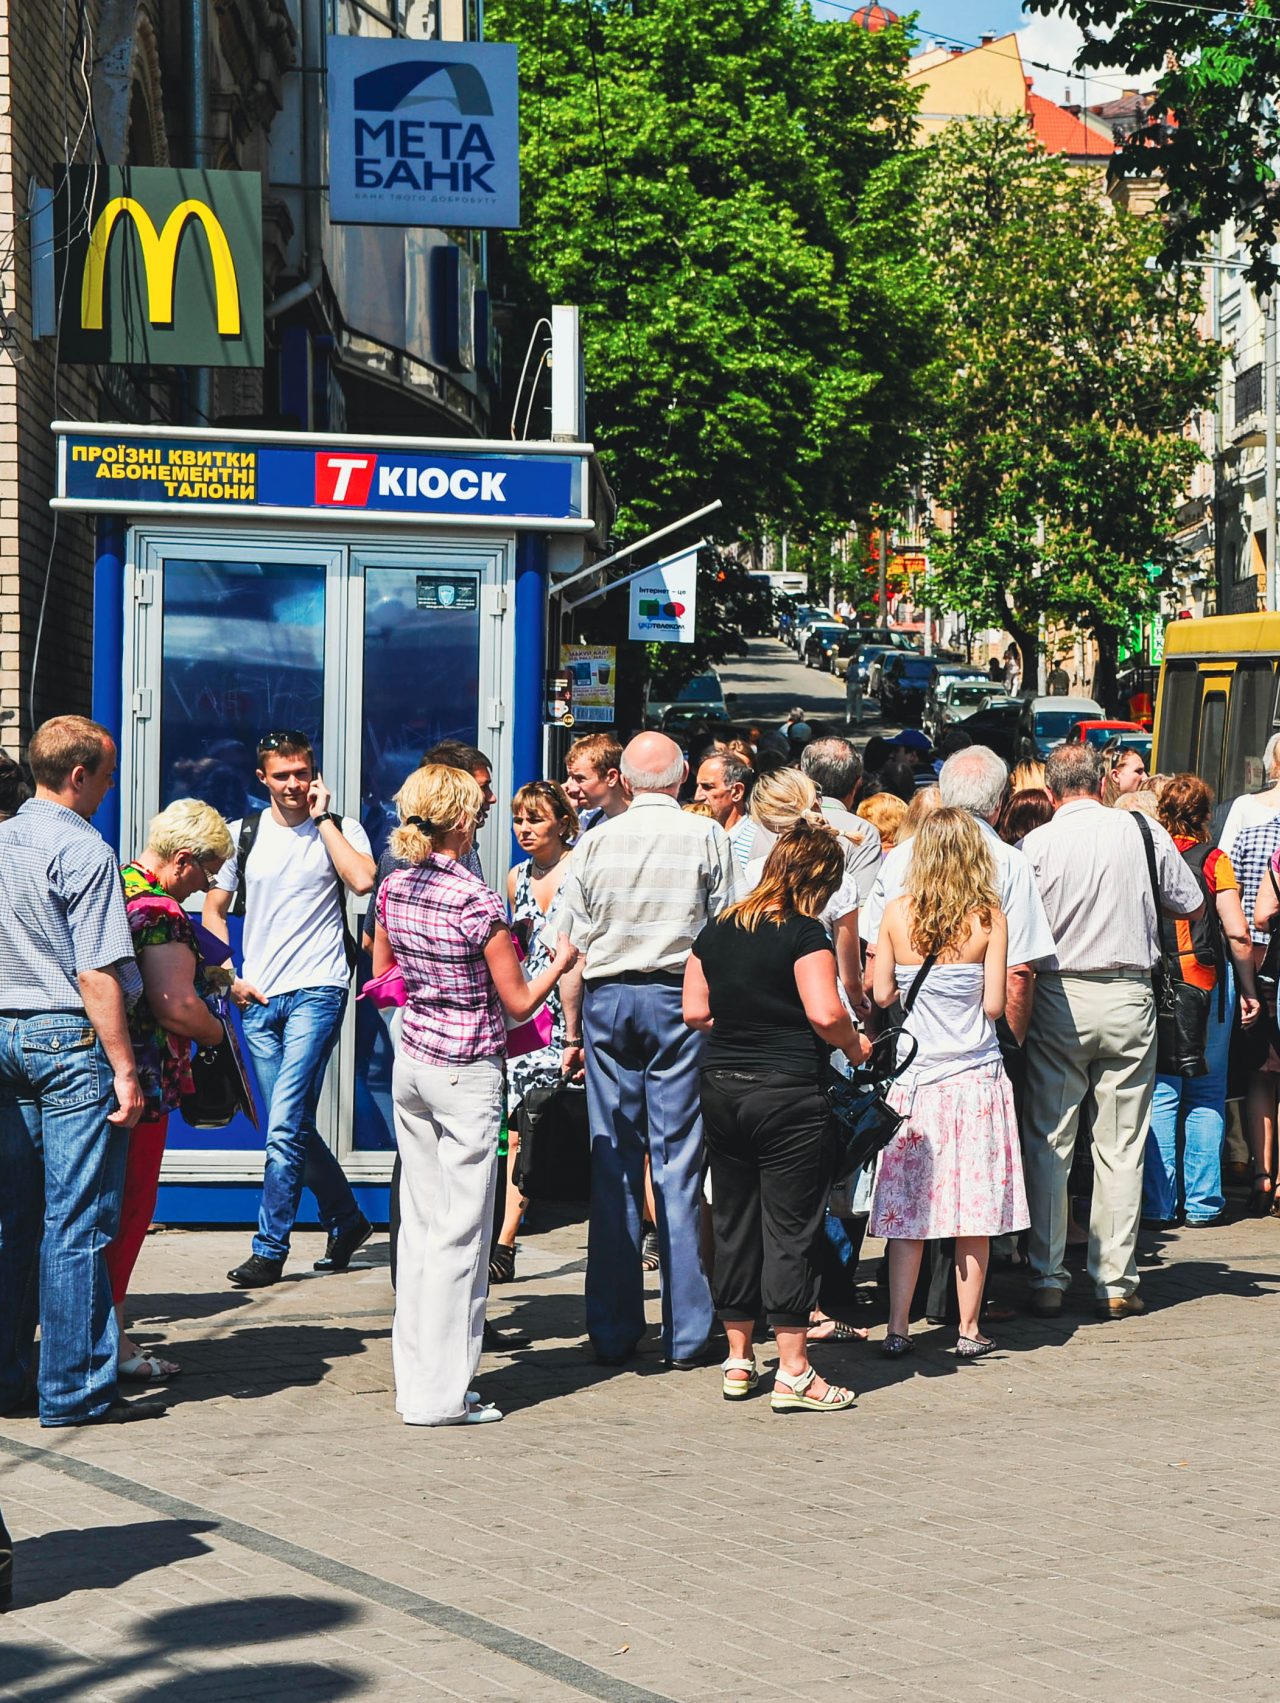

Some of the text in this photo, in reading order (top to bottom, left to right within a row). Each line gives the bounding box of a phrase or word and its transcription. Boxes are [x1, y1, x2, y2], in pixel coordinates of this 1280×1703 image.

[354, 118, 495, 161] МЕТА
[355, 158, 496, 193] БАНК
[430, 195, 497, 204] ДОБРОБУТУ
[72, 444, 255, 468] ПРОЇЗНІ КВИТКИ
[96, 463, 255, 484] АБОНЕМЕНТНІ
[378, 466, 507, 502] КІОСК
[164, 481, 255, 500] ТАЛОНИ
[639, 586, 669, 595] Інтернет
